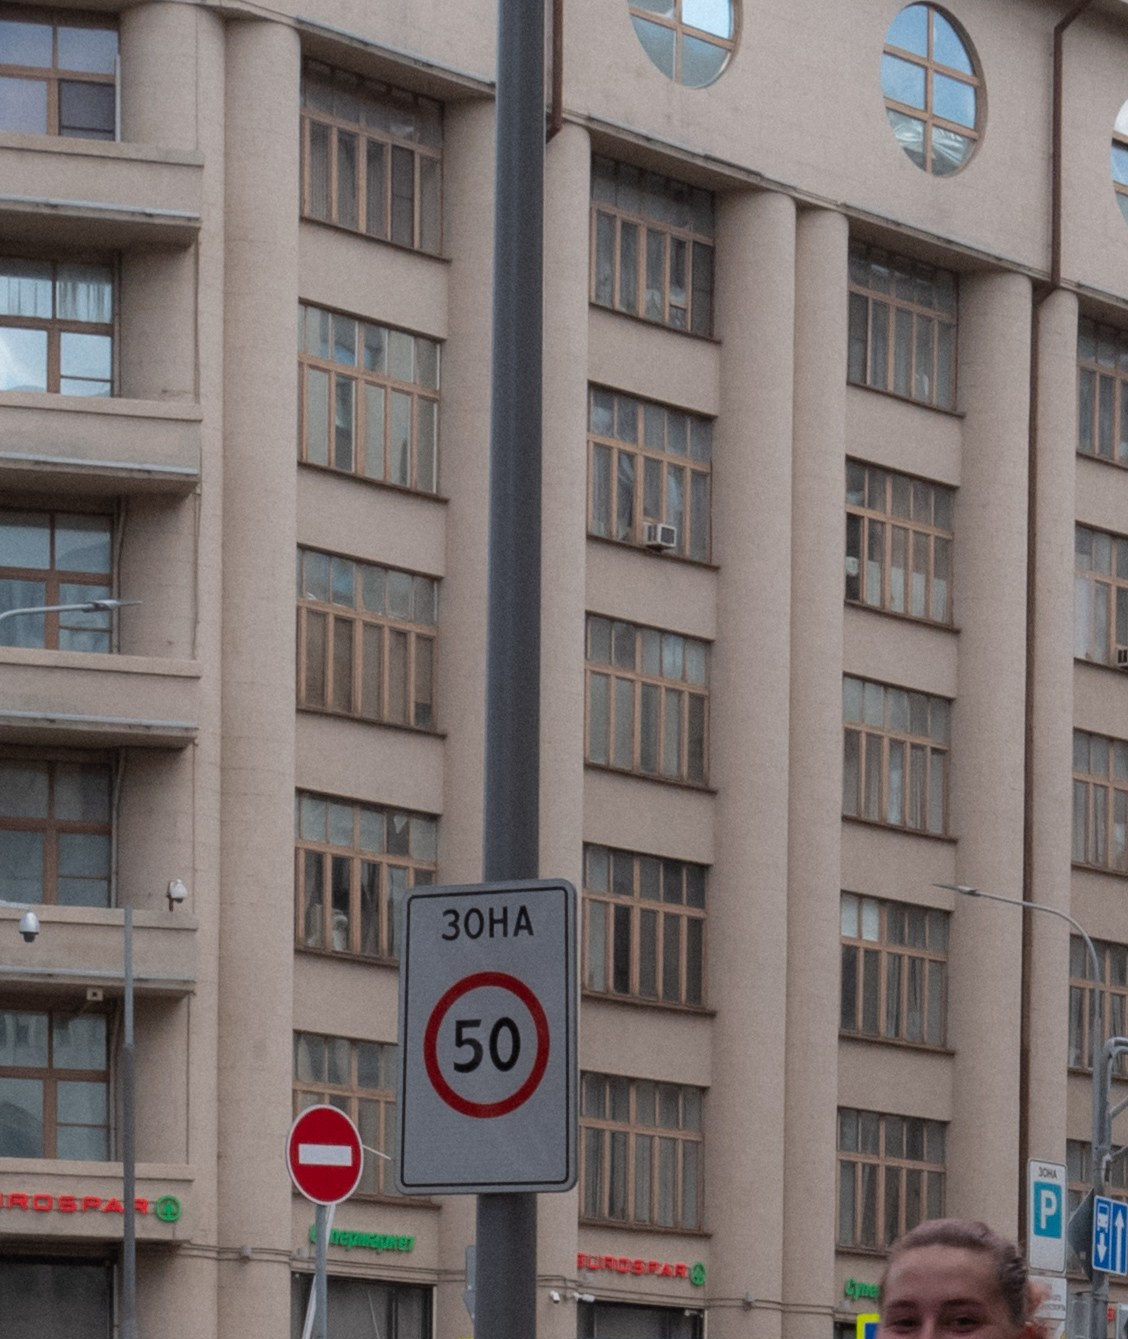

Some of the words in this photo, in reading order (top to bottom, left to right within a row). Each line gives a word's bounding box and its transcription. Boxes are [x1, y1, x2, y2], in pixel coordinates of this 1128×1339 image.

[442, 905, 534, 941] ЗОНА
[453, 1017, 521, 1073] 50
[1038, 1166, 1057, 1179] ЗОНА
[0, 1192, 149, 1216] ROSPAR
